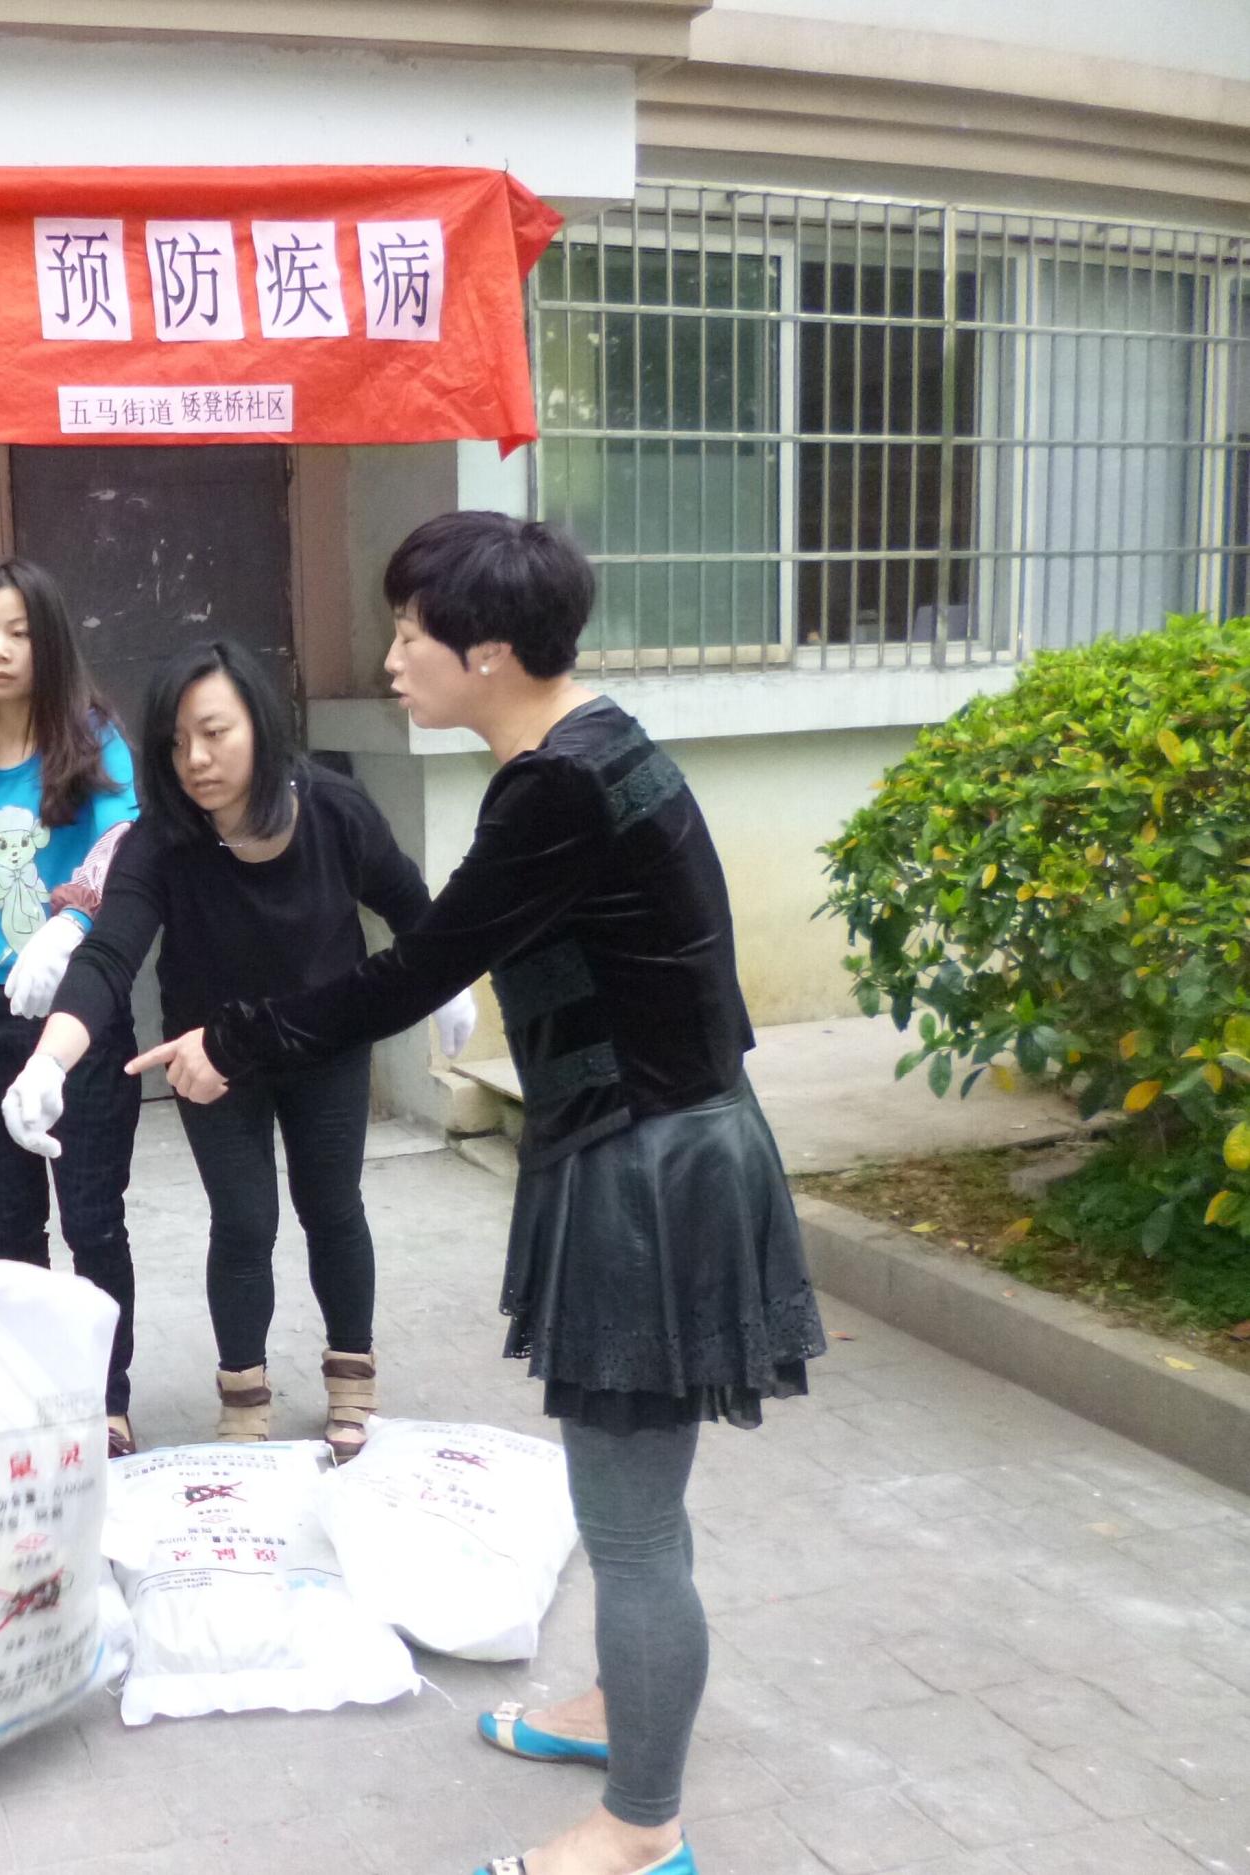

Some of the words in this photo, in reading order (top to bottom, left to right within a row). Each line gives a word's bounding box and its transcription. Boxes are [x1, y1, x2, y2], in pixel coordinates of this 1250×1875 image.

[45, 232, 430, 328] 预防疾病
[68, 398, 174, 426] 五马街道
[181, 390, 285, 423] 矮凳桥社区
